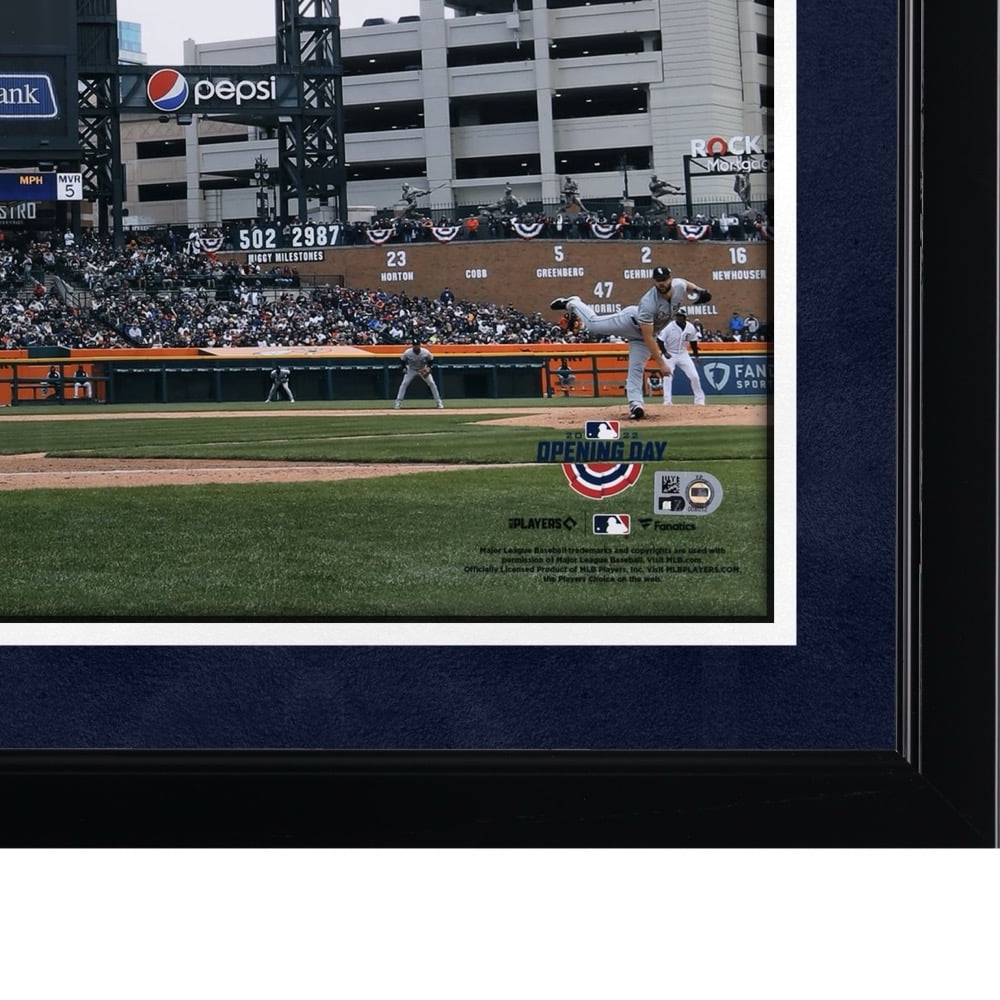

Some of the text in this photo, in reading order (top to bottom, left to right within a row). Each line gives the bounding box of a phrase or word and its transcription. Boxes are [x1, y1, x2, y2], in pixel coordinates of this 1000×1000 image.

[194, 75, 277, 106] pepsi
[19, 175, 43, 185] MPH
[58, 174, 81, 184] MVR
[240, 225, 340, 250] 502 2987
[248, 251, 324, 264] MIGGY MILESTONES
[386, 250, 407, 268] 23
[553, 245, 565, 262] 5
[641, 246, 652, 264] 2
[729, 247, 748, 264] 16
[381, 271, 414, 282] HORTON
[465, 268, 488, 279] COBB
[536, 267, 584, 279] GREENBERG
[593, 281, 614, 299] 47
